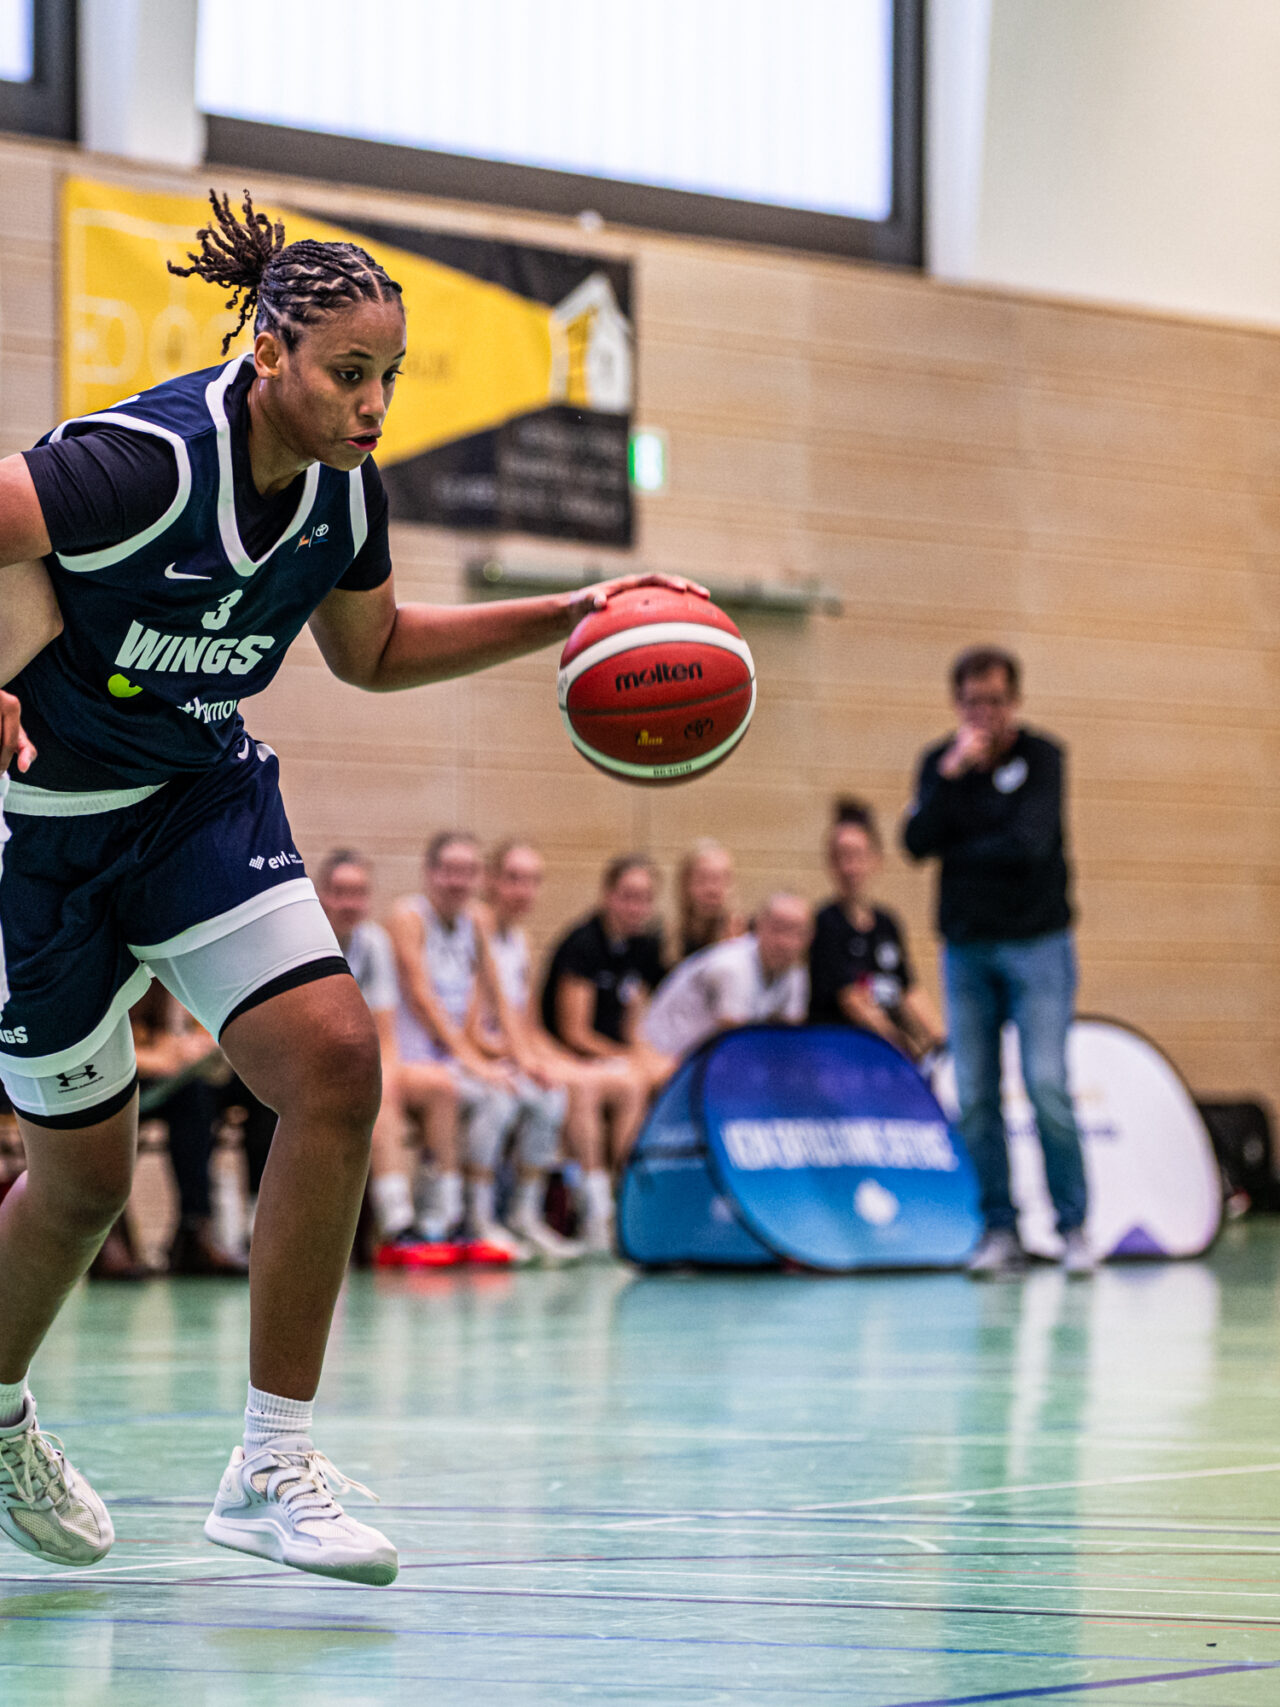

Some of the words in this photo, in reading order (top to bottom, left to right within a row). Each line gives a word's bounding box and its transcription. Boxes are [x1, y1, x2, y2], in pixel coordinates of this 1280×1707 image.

[201, 589, 243, 630] 3
[114, 619, 276, 675] WINGS
[615, 662, 703, 692] molten
